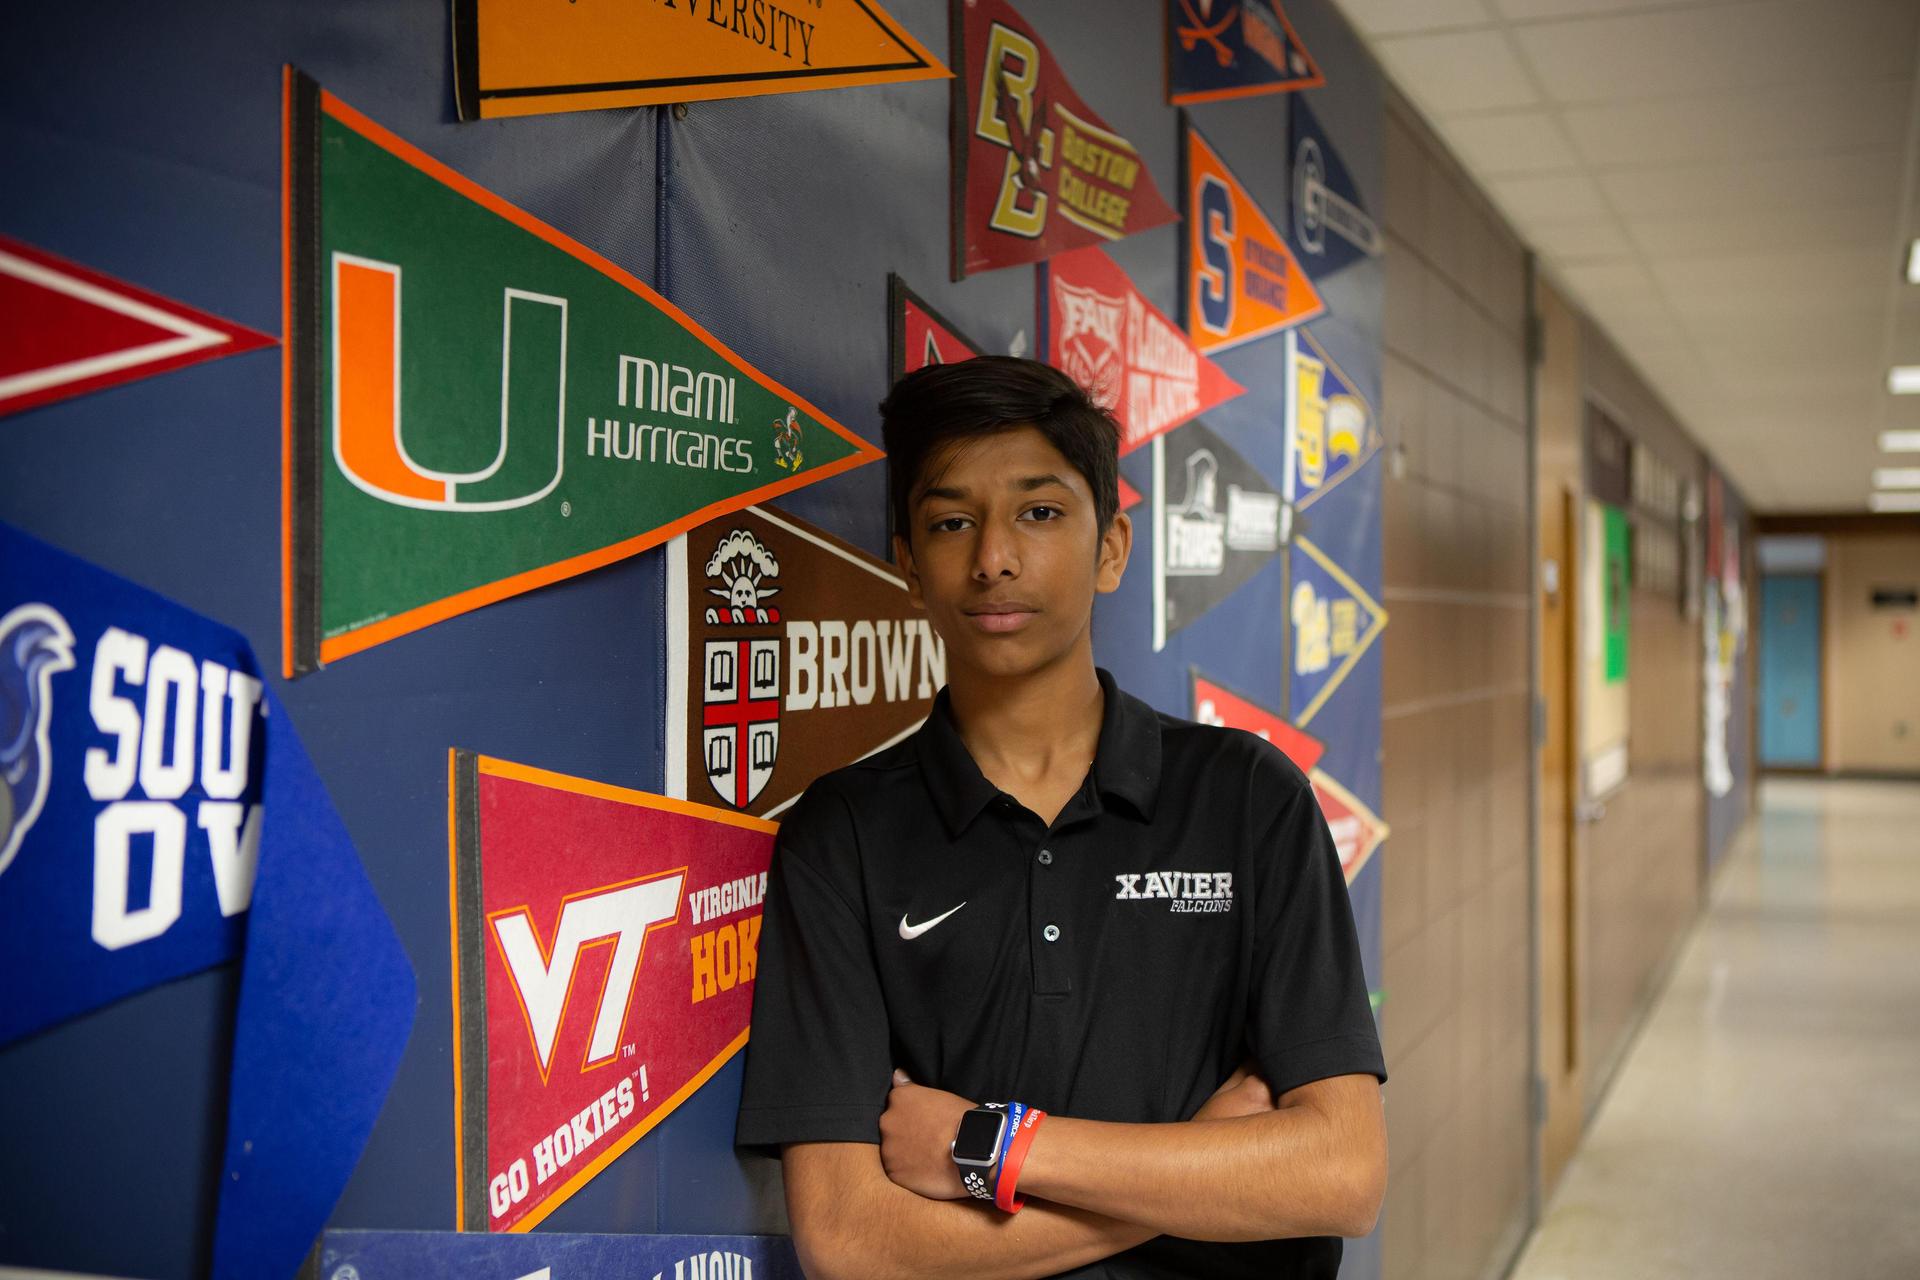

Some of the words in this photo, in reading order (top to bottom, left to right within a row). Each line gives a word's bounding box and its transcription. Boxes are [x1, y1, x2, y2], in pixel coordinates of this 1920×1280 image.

[664, 0, 815, 66] ERSITY
[1057, 164, 1131, 229] COLLEGE
[1197, 173, 1236, 336] S
[331, 250, 568, 512] U
[784, 618, 947, 712] BROWN
[83, 625, 264, 801] SOU
[688, 871, 768, 926] VIRGINIA
[1115, 871, 1233, 900] XAVIER
[1170, 899, 1233, 913] FALCONS
[486, 865, 689, 1088] VT
[489, 1158, 530, 1219] GO
